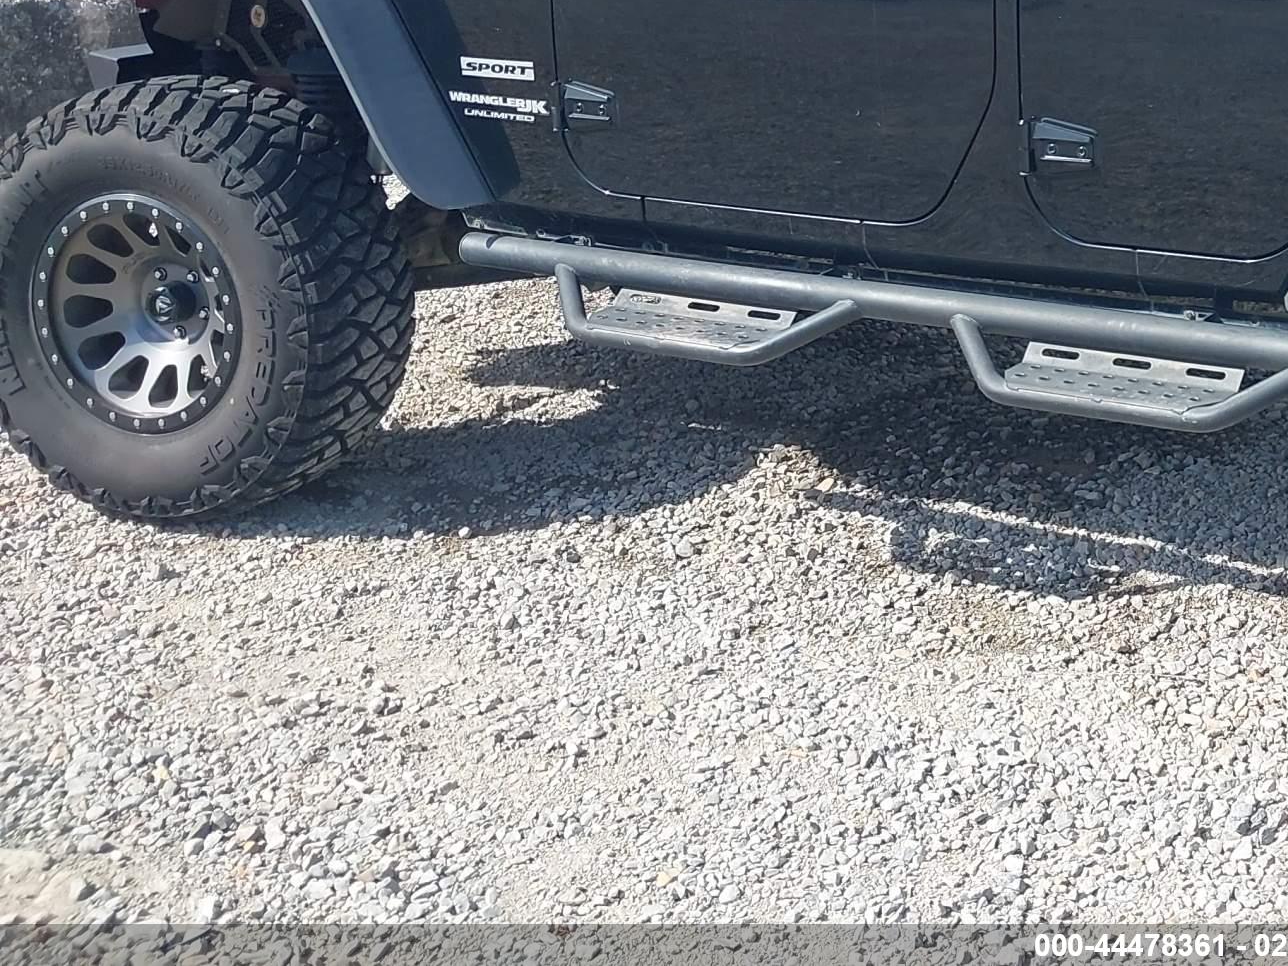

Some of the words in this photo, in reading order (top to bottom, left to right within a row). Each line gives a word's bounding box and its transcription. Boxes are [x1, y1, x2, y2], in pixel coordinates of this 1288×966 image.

[463, 60, 532, 76] SPORT
[463, 108, 535, 122] UNLIMITED
[199, 308, 277, 476] PREDATOR
